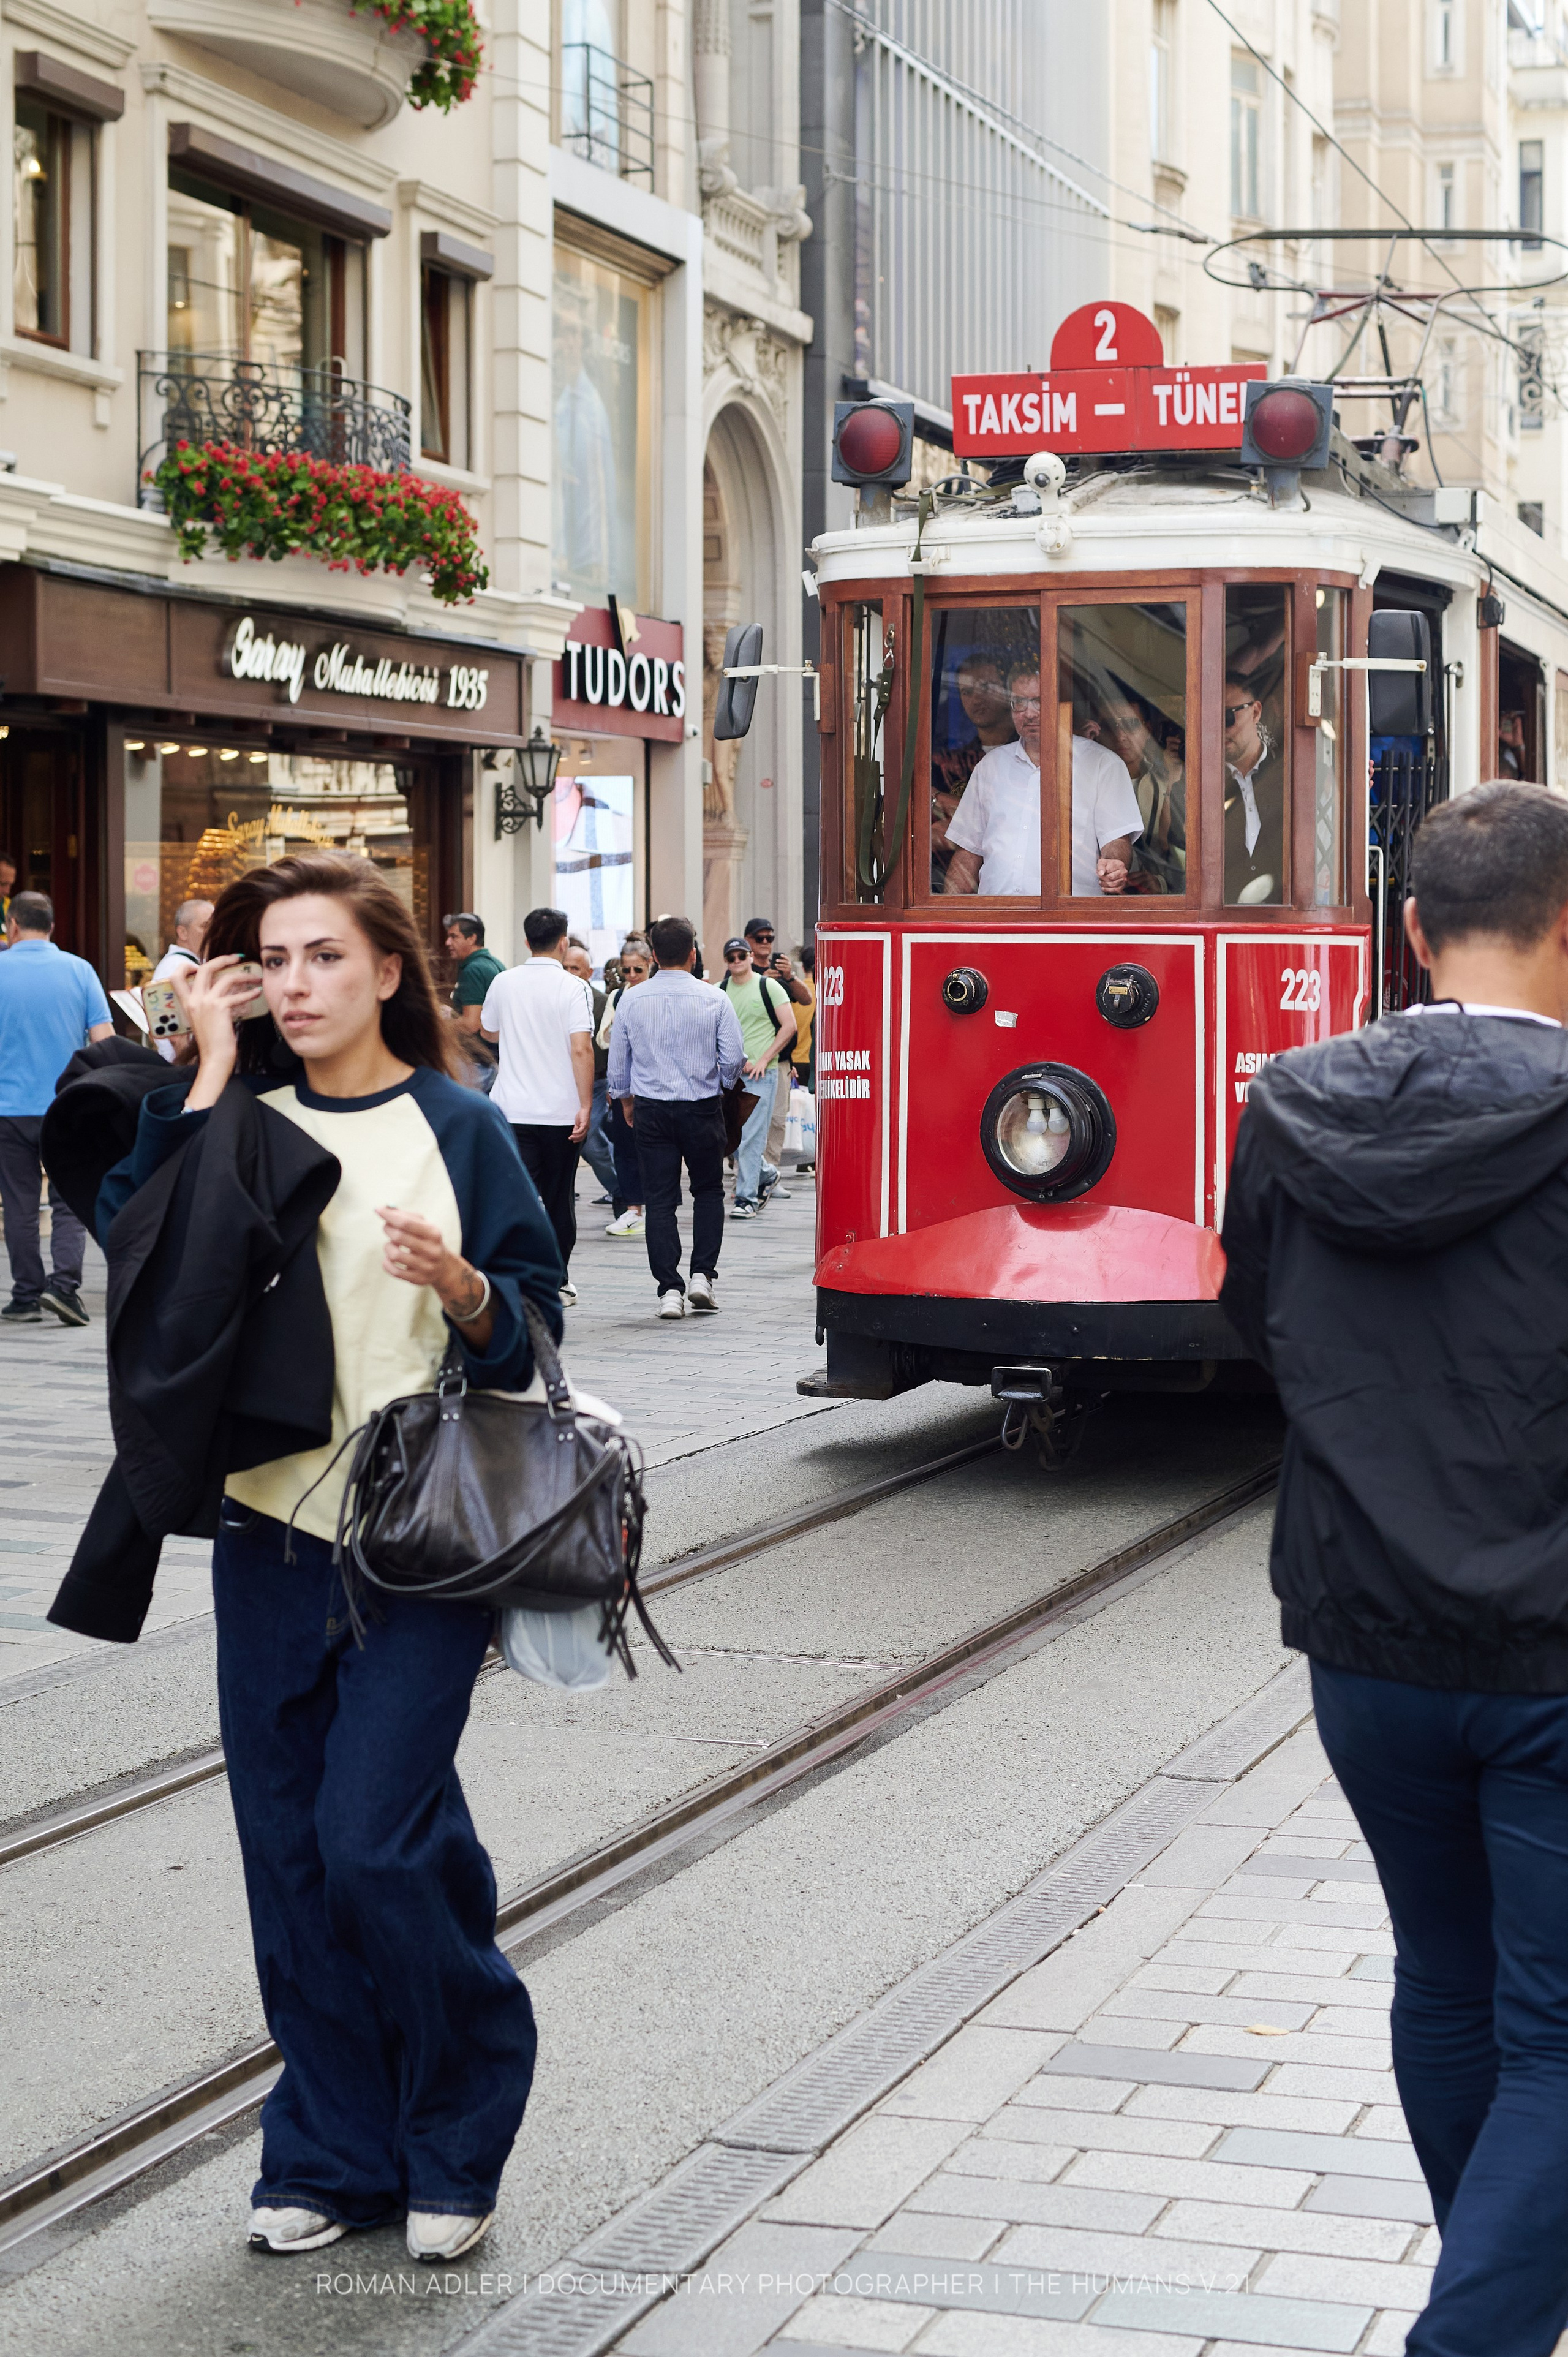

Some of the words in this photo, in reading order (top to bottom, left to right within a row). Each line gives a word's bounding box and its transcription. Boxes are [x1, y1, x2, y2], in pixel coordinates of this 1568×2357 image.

[1093, 309, 1118, 361] 2
[963, 381, 1077, 436] TAKSİM
[230, 616, 306, 704] Saray
[314, 642, 439, 704] Muhallebicisi
[447, 664, 489, 711] 1935
[566, 639, 685, 718] TUDORS
[823, 965, 844, 1006] 223
[1280, 968, 1321, 1012] 223
[834, 1050, 871, 1071] YASAK
